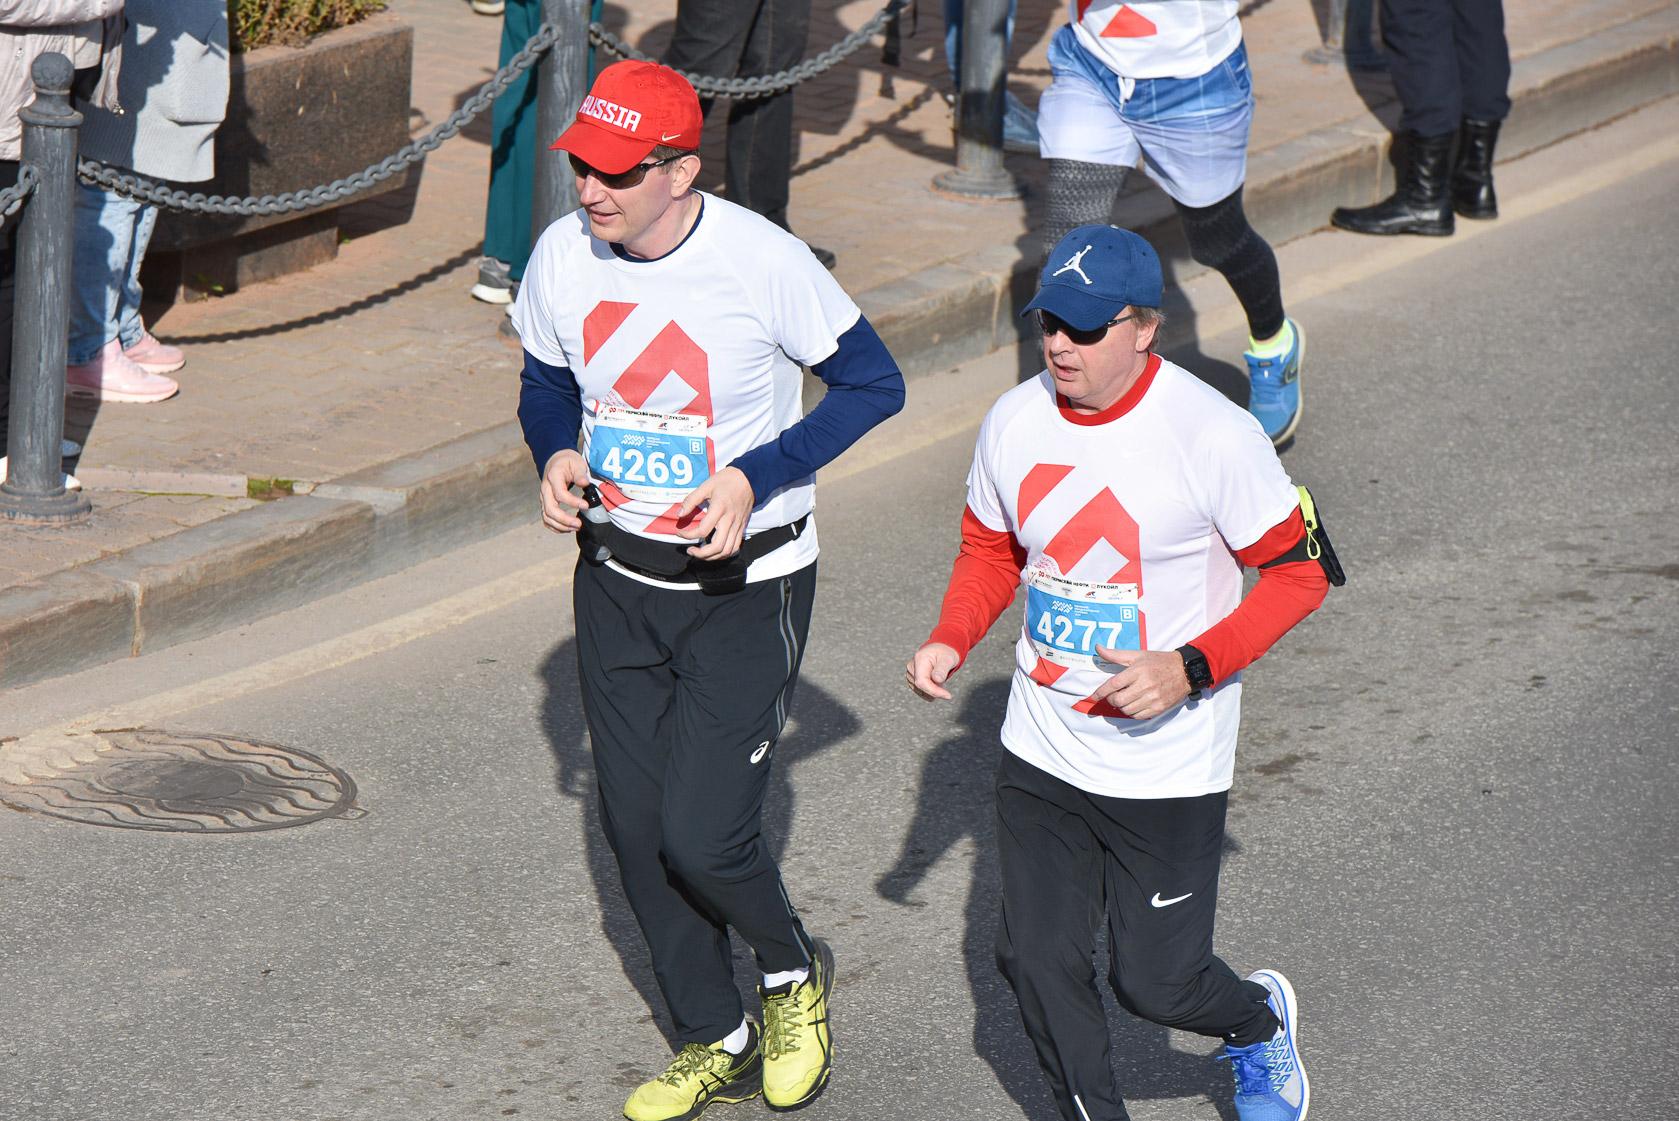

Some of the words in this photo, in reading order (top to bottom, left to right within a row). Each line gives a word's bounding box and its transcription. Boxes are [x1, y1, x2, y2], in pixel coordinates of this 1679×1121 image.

[579, 94, 641, 132] RUSSIA
[602, 447, 693, 485] 4269
[692, 442, 701, 452] B
[1037, 611, 1122, 651] 4277
[1123, 609, 1132, 619] B
